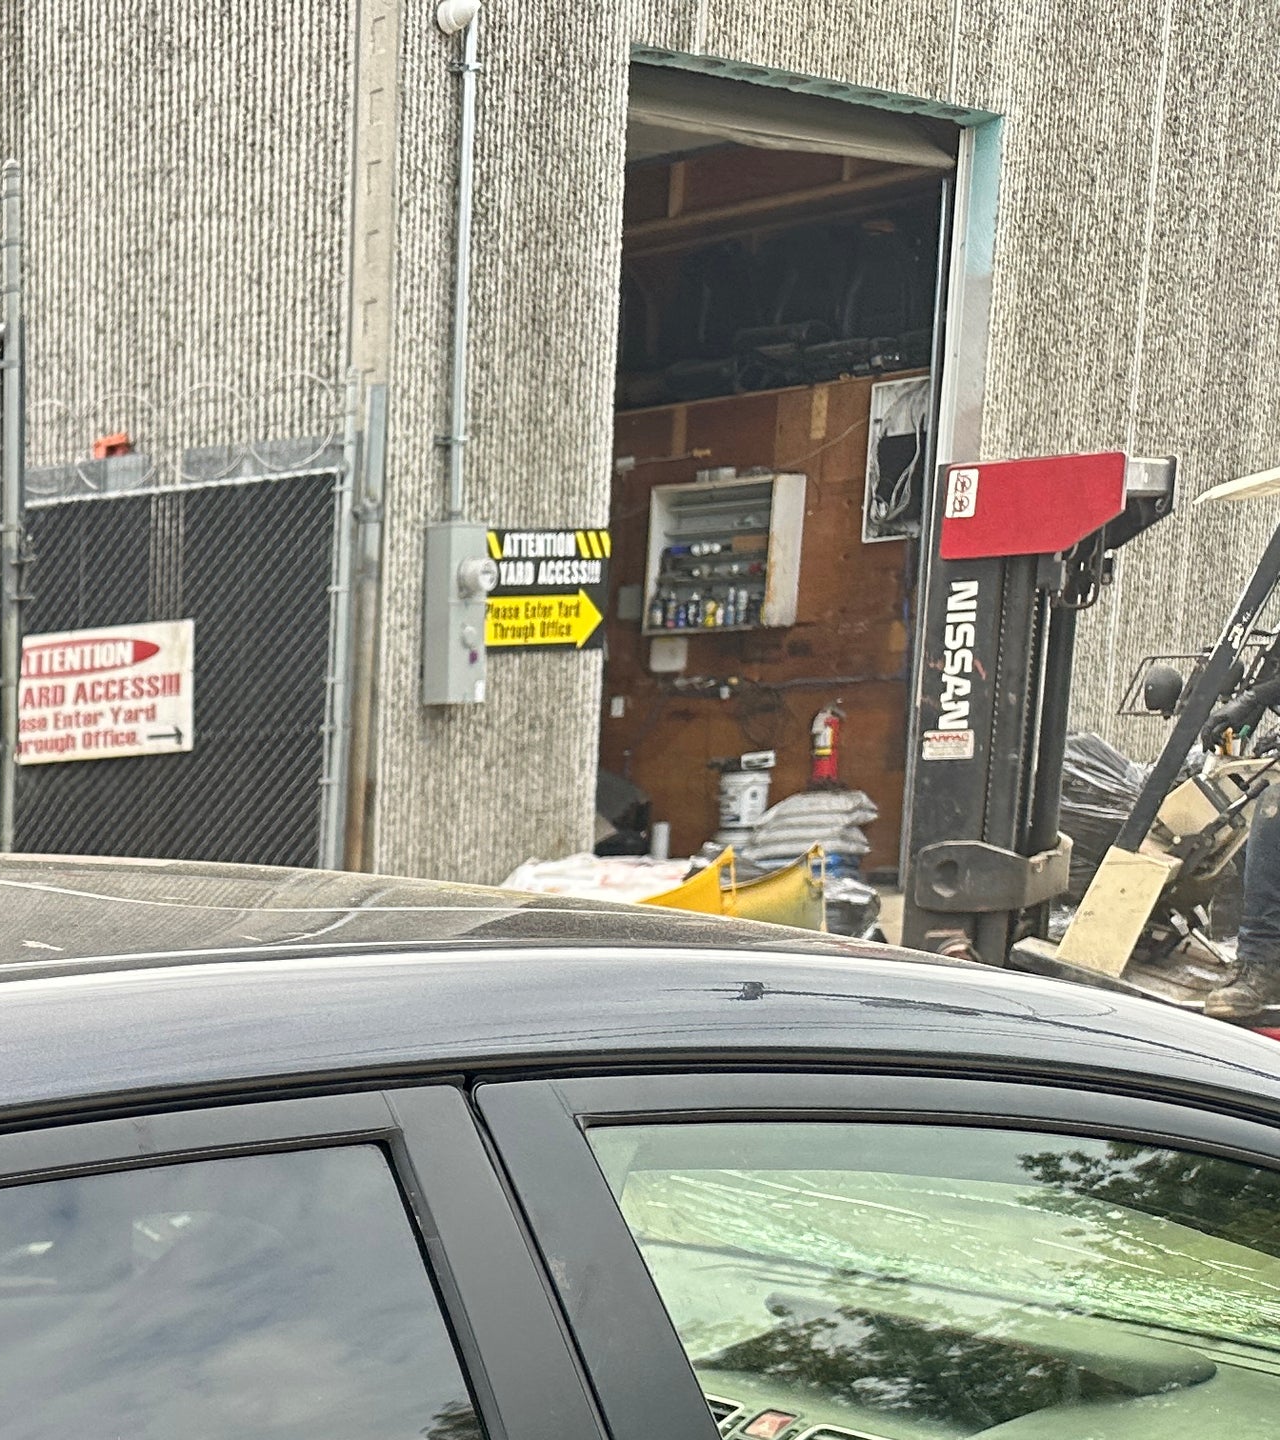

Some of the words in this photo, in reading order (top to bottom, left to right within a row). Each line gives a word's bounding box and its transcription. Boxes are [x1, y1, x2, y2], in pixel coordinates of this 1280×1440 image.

[502, 532, 577, 558] ATTENTION
[499, 560, 535, 585] YARD
[538, 559, 602, 585] ACCESS!!!
[524, 601, 553, 620] Enter
[558, 600, 581, 619] Yard
[494, 620, 535, 643] Through
[540, 620, 572, 638] Office
[22, 640, 134, 676] TTENTION
[938, 580, 979, 730] NISSAN
[23, 684, 65, 710] ARD
[53, 709, 104, 730] Enter
[110, 703, 157, 726] Yard
